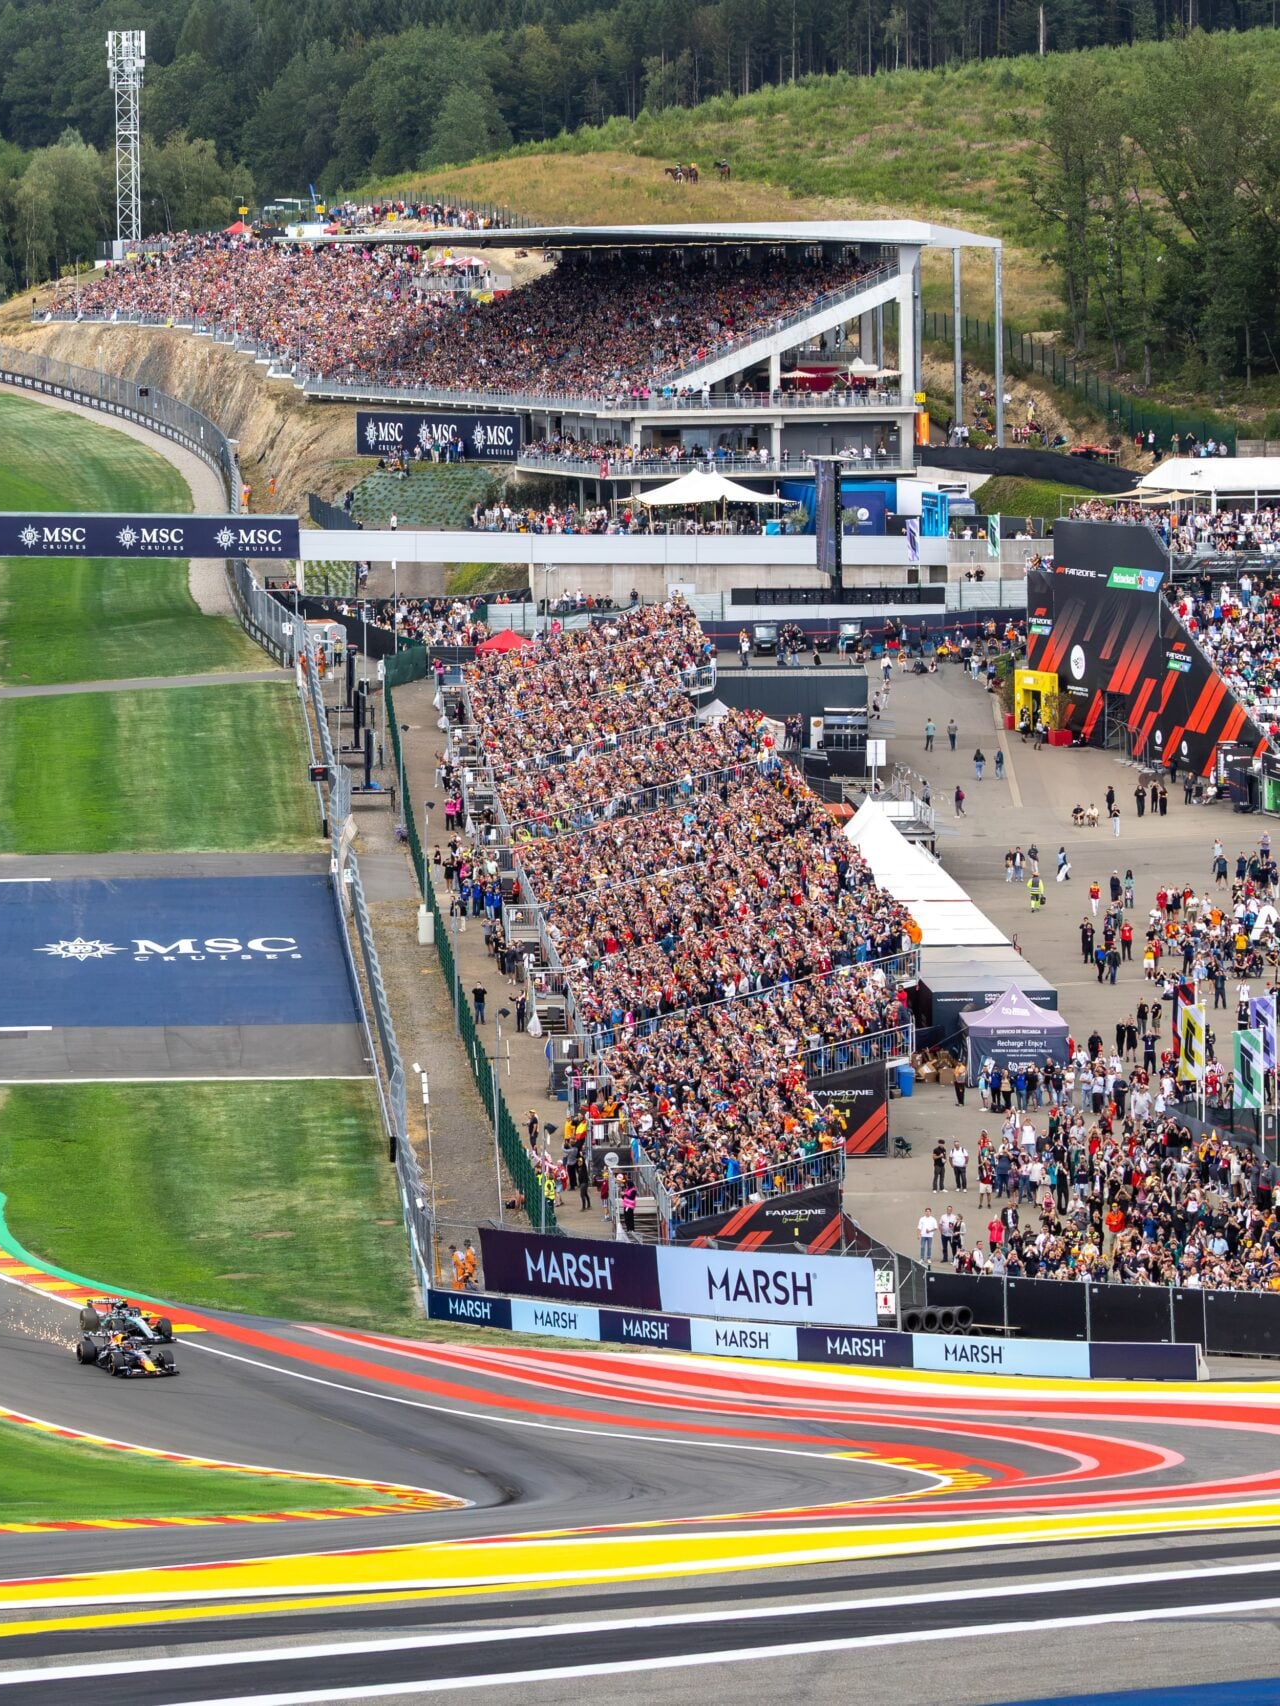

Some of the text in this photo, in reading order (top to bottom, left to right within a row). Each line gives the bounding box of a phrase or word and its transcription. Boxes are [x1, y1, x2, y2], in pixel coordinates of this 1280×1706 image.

[378, 422, 403, 442] MSC
[432, 424, 457, 443] MSC
[487, 426, 513, 445] MSC
[43, 528, 86, 542] MSC
[140, 528, 184, 543] MSC
[238, 529, 282, 544] MSC
[1065, 568, 1096, 578] FANZONE
[1166, 651, 1192, 662] FANZONE
[131, 937, 298, 954] MSC
[134, 954, 302, 962] CRUISES
[524, 1248, 613, 1291] MARSH
[707, 1266, 813, 1306] MARSH
[448, 1298, 491, 1320] MARSH
[534, 1310, 576, 1330] MARSH
[622, 1318, 668, 1340] MARSH
[715, 1329, 769, 1350] MARSH
[826, 1336, 884, 1357] MARSH
[944, 1343, 1002, 1364] MARSH
